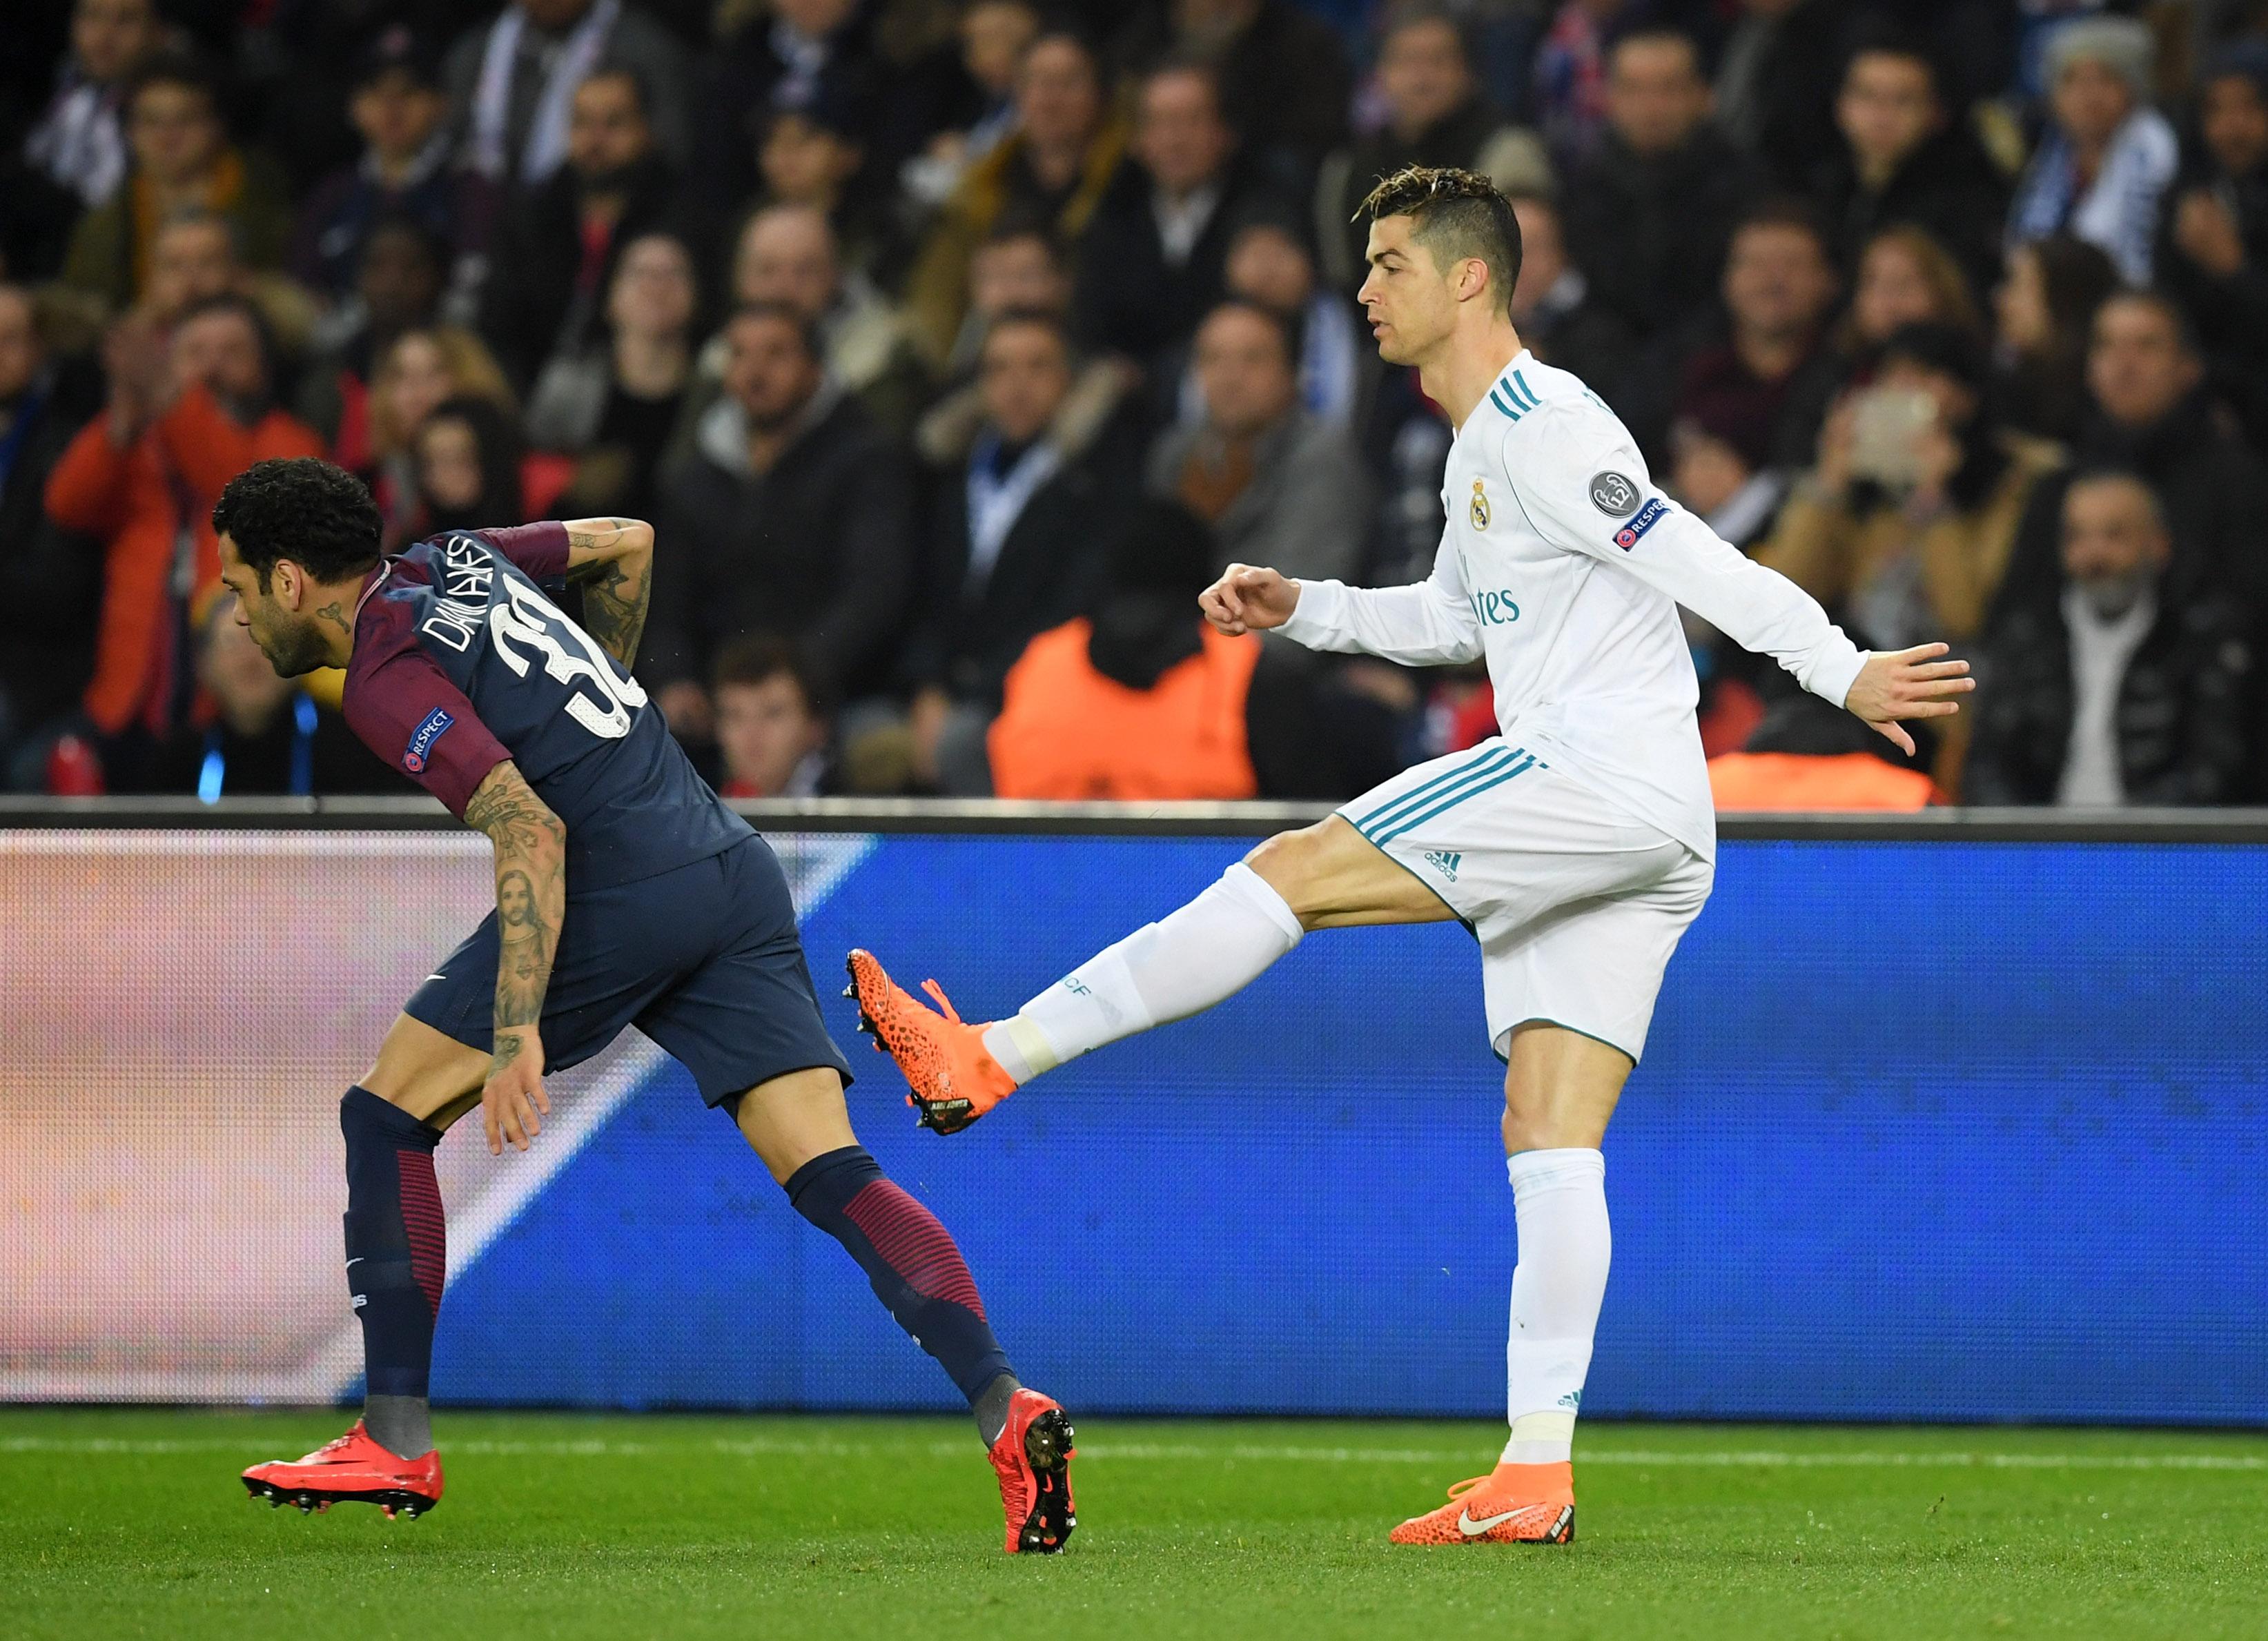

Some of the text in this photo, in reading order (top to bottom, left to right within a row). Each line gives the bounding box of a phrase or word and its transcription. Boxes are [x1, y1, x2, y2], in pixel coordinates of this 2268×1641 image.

[1610, 489, 1630, 508] 12
[422, 535, 493, 652] DANI ALVES
[1474, 587, 1521, 626] tes
[489, 573, 649, 738] 32
[413, 711, 448, 756] RESPECT
[1424, 852, 1458, 883] adidas
